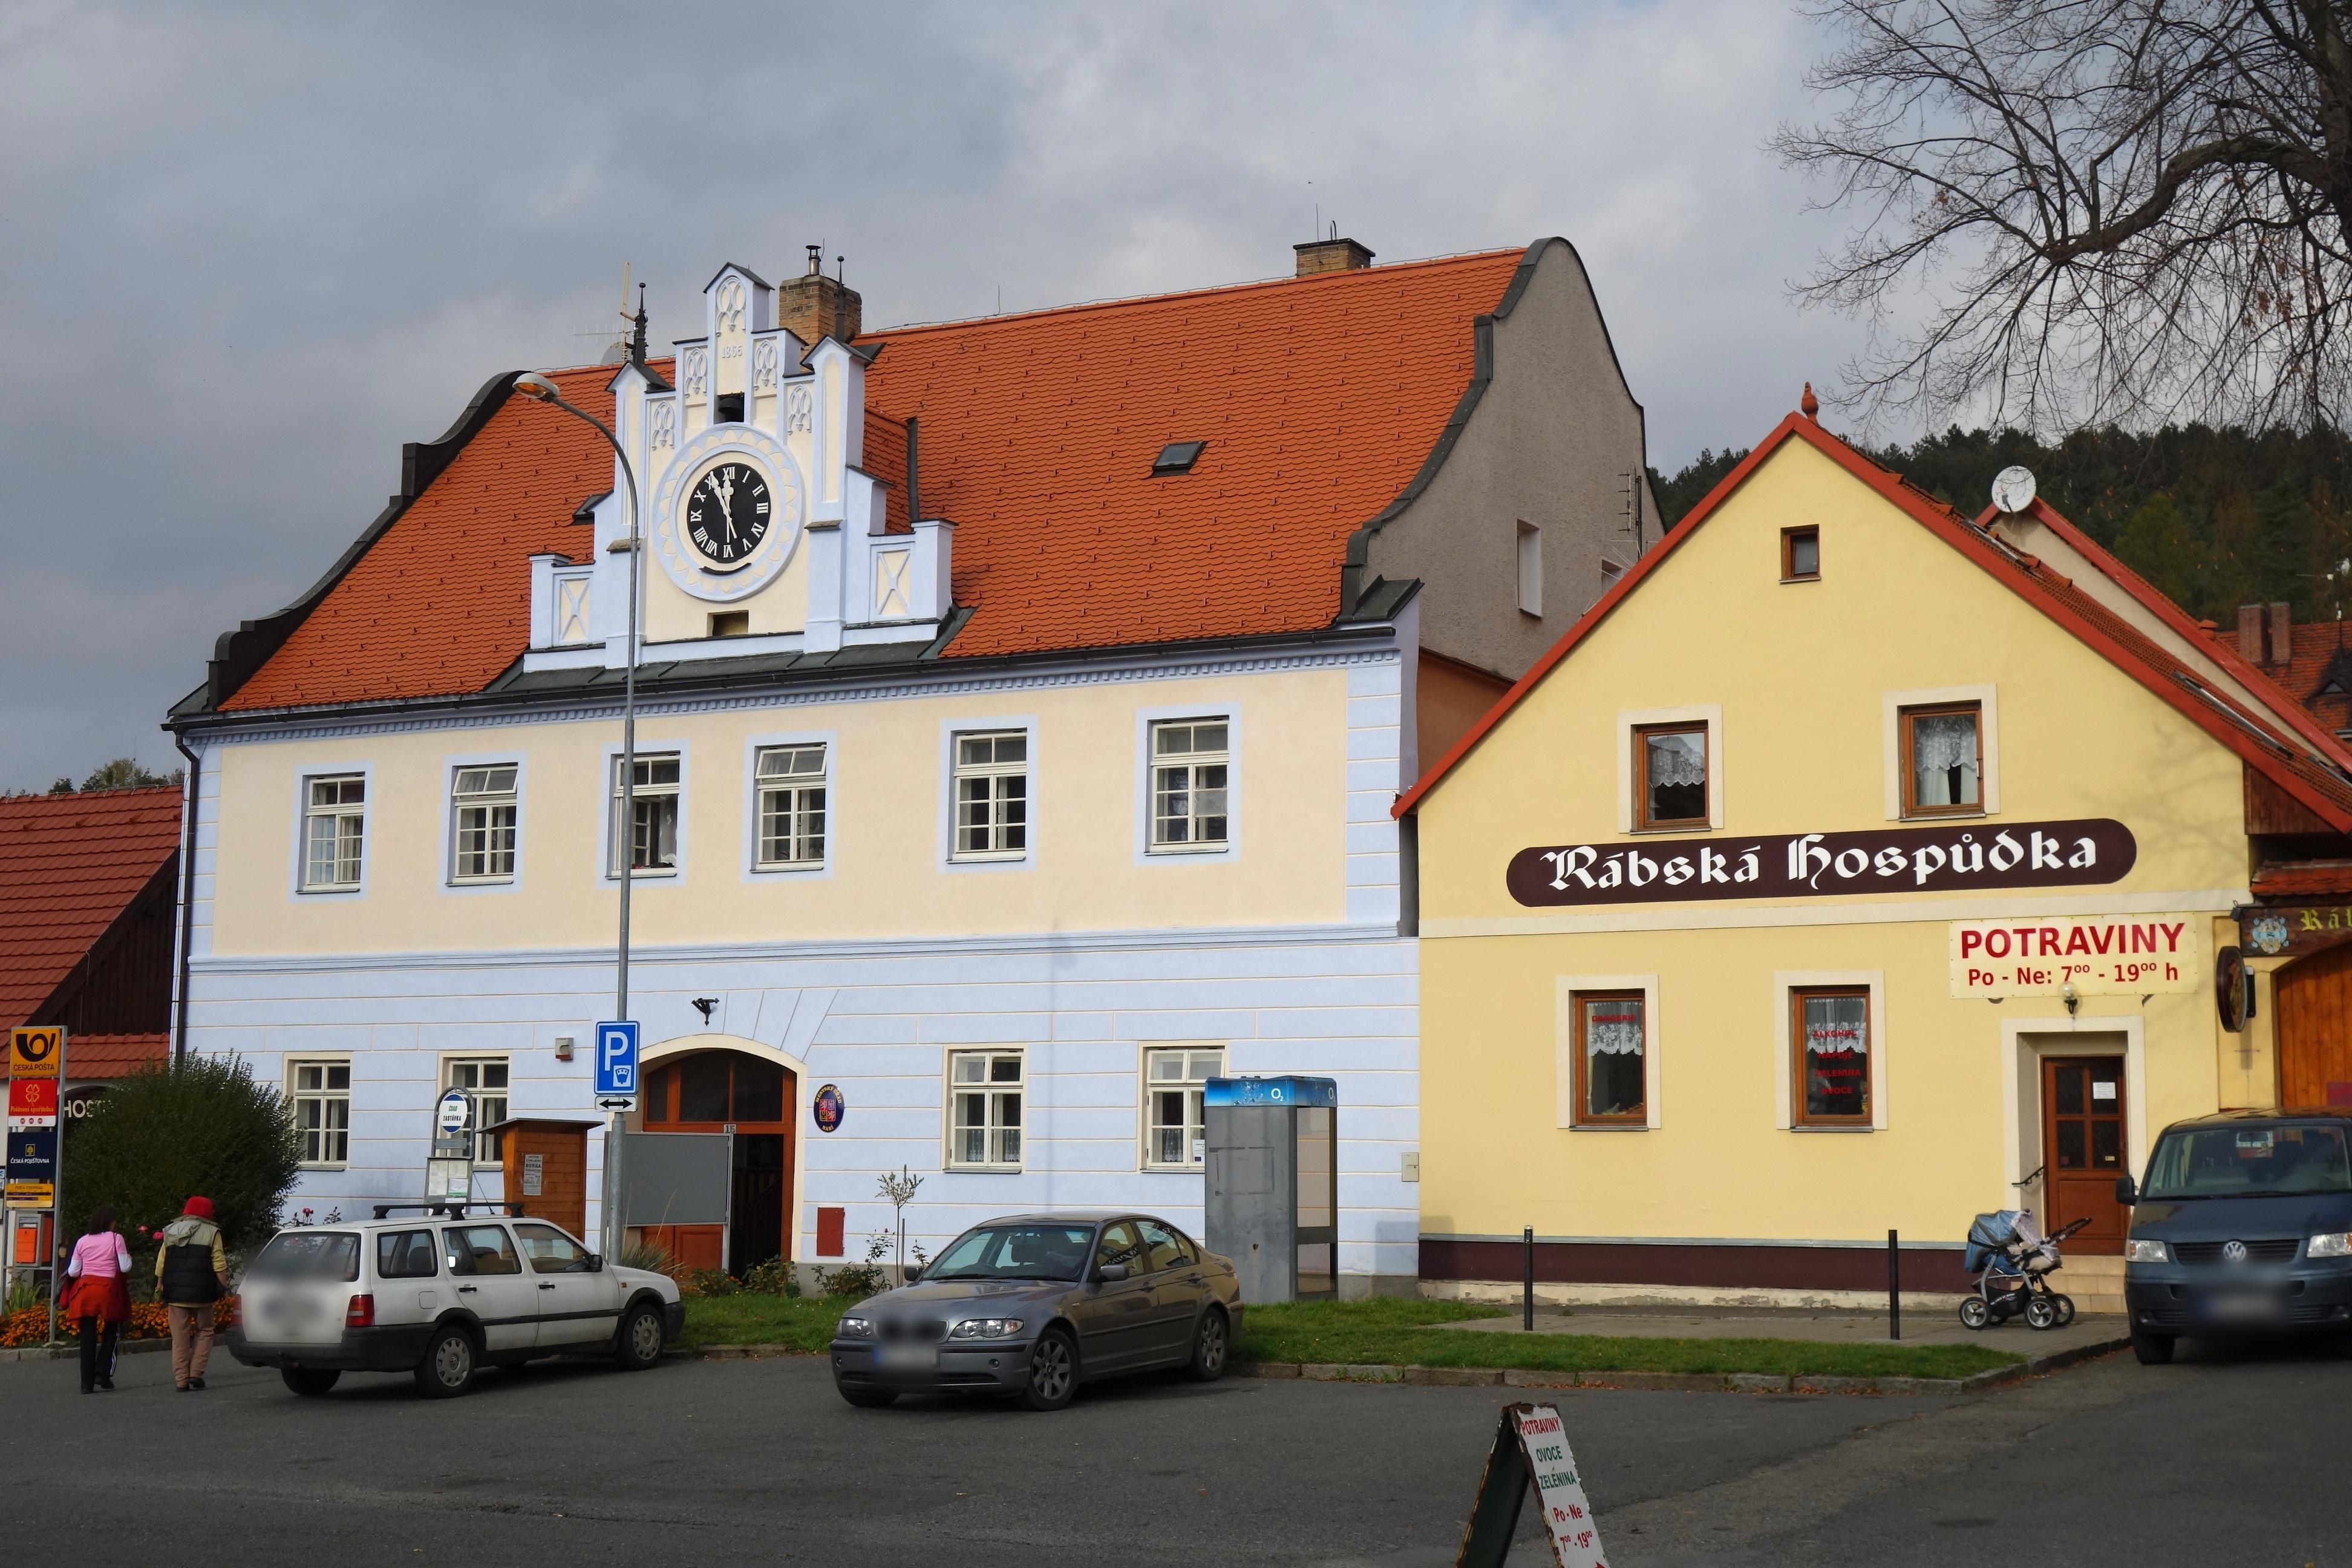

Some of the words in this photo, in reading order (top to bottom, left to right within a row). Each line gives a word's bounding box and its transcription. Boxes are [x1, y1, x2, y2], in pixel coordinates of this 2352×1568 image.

[694, 489, 707, 503] X
[1540, 846, 1761, 890] Rábská
[1788, 829, 2096, 890] Hospůdka
[1961, 923, 2185, 959] POTRAVINY
[1968, 969, 1994, 986] Po
[2017, 967, 2051, 985] Ne:
[2166, 962, 2178, 981] h
[605, 1031, 629, 1071] P
[725, 1125, 736, 1133] 15
[1521, 1417, 1561, 1436] POTRAVINY
[1536, 1446, 1563, 1463] OVOCE
[1538, 1471, 1577, 1489] ZELENINA
